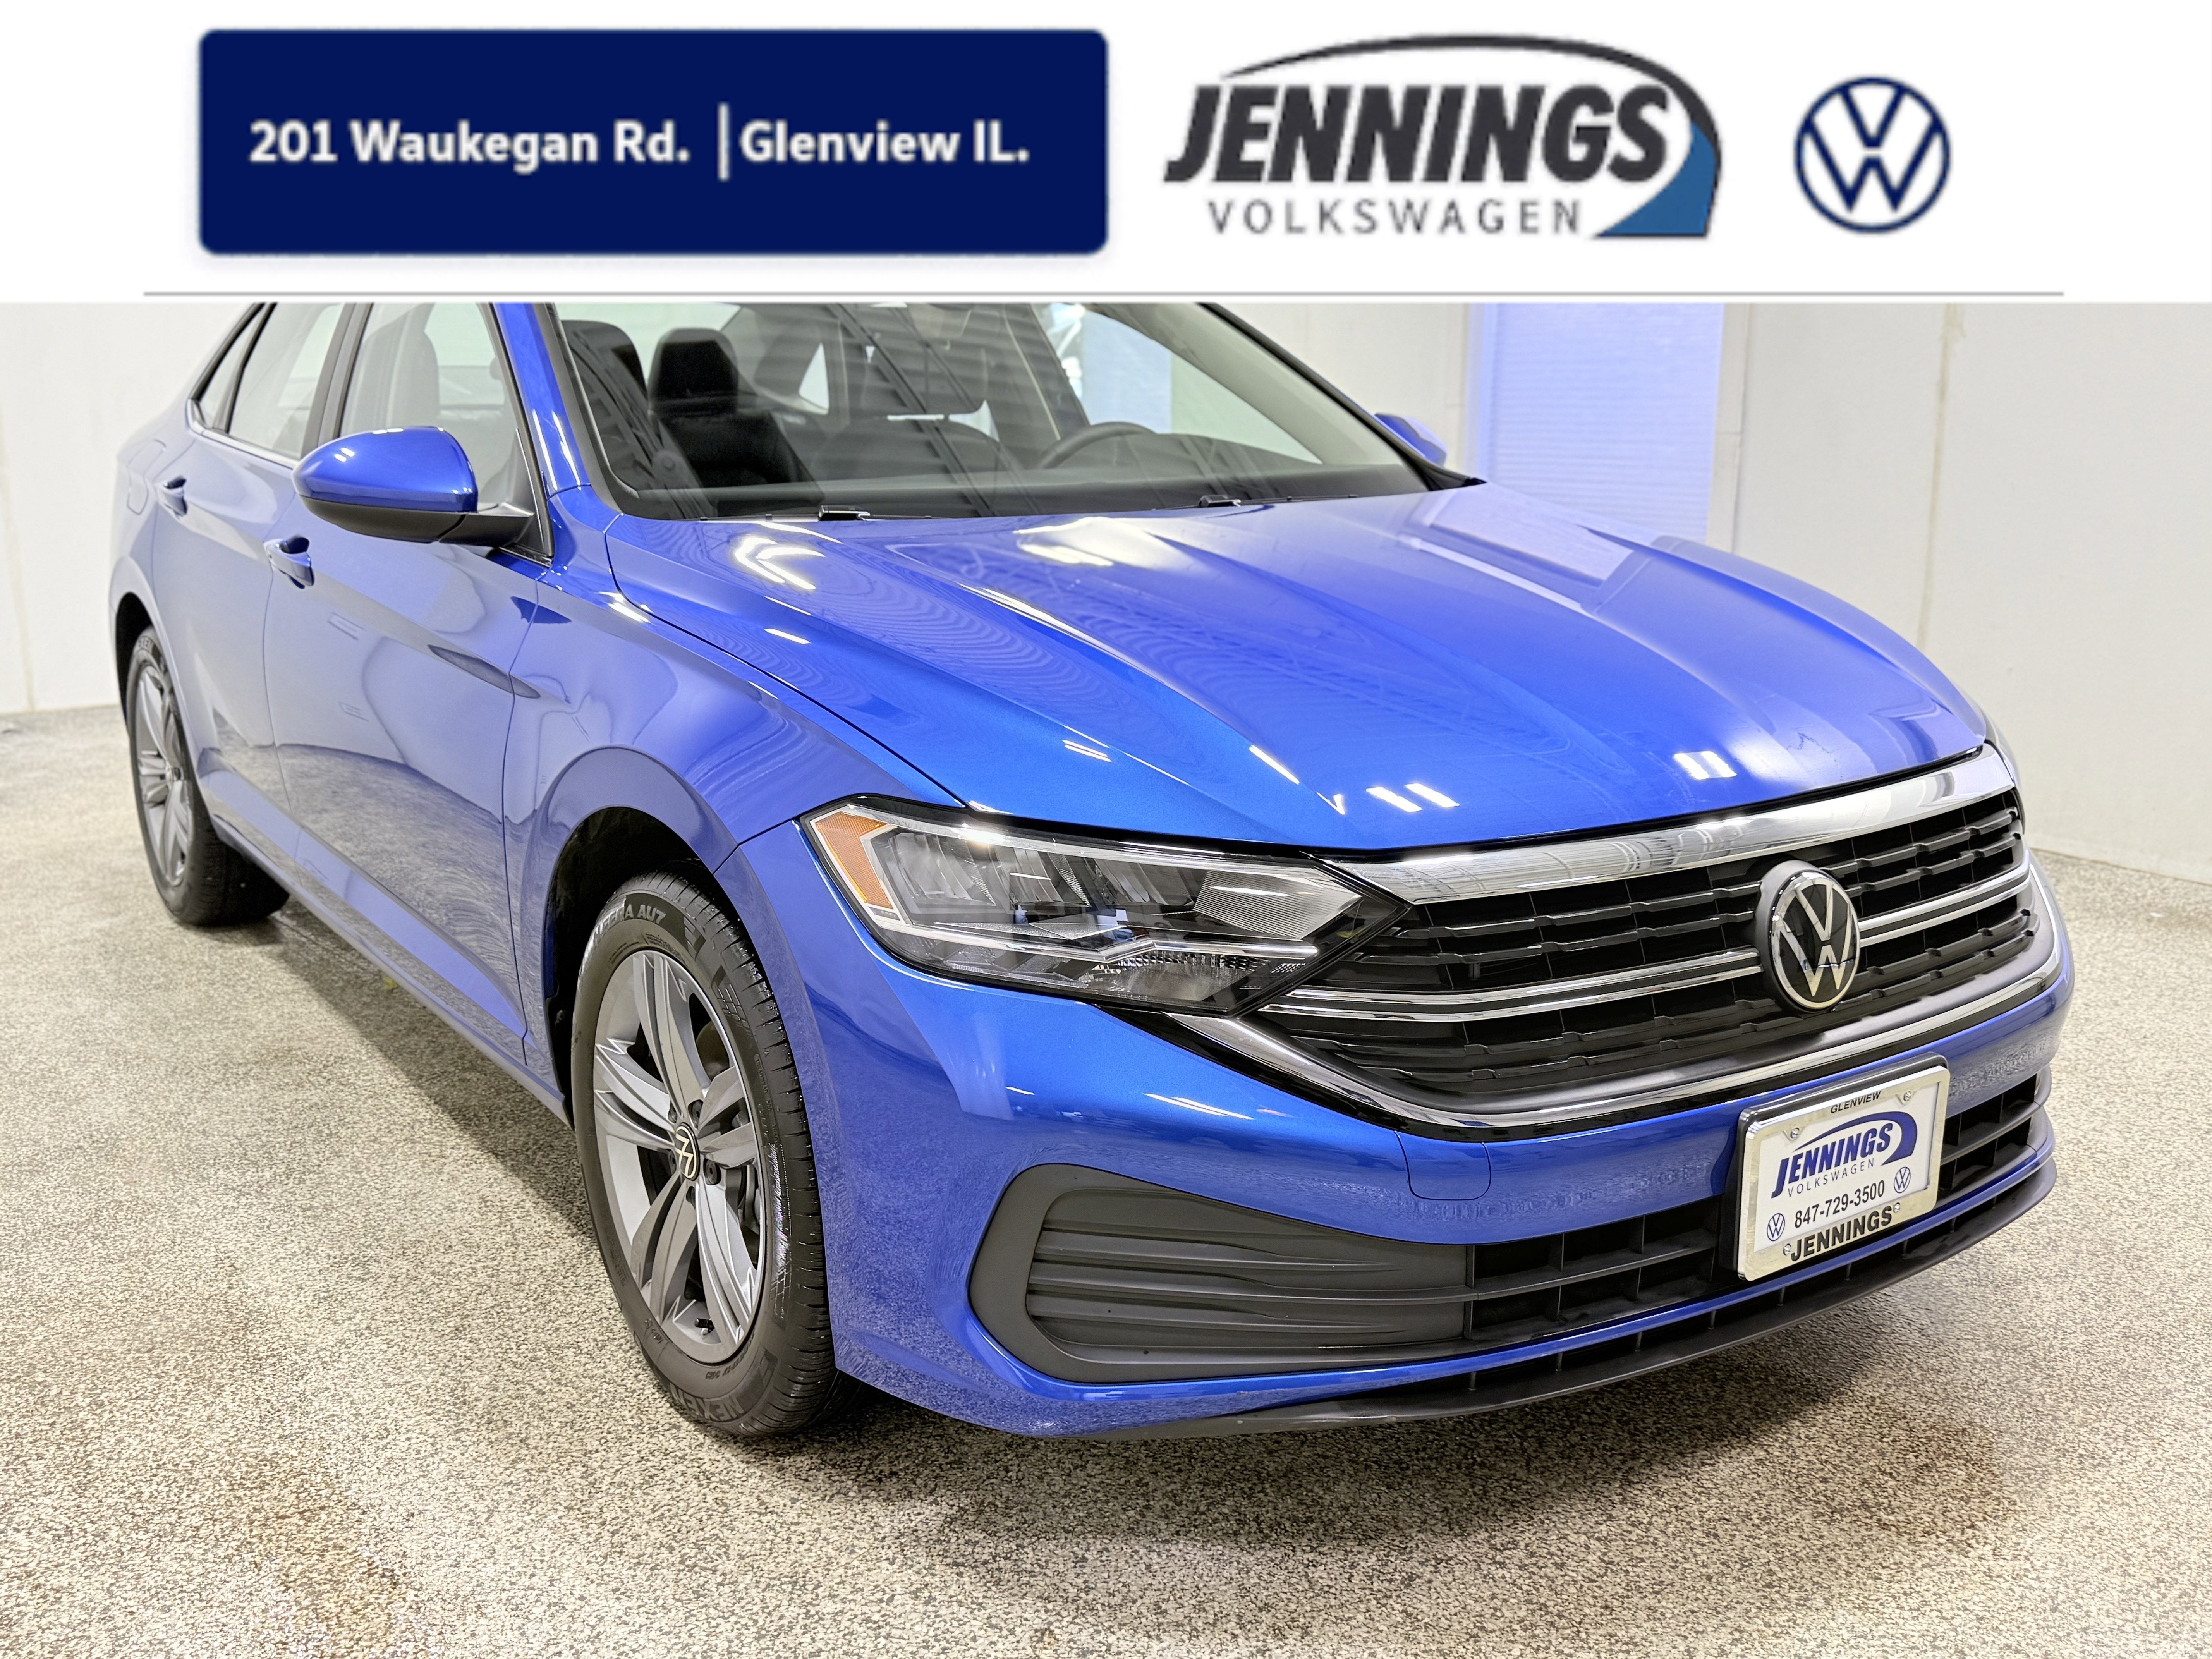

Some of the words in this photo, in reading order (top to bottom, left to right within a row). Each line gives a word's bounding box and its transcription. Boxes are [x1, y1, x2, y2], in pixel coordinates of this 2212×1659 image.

[1831, 1090, 1881, 1114] GLENVIEW
[1771, 1122, 1893, 1199] JENNINGS
[1788, 1158, 1875, 1197] VOLKSWAGEN
[1794, 1179, 1885, 1228] 847-729-3500
[1791, 1205, 1893, 1261] JENNINGS
